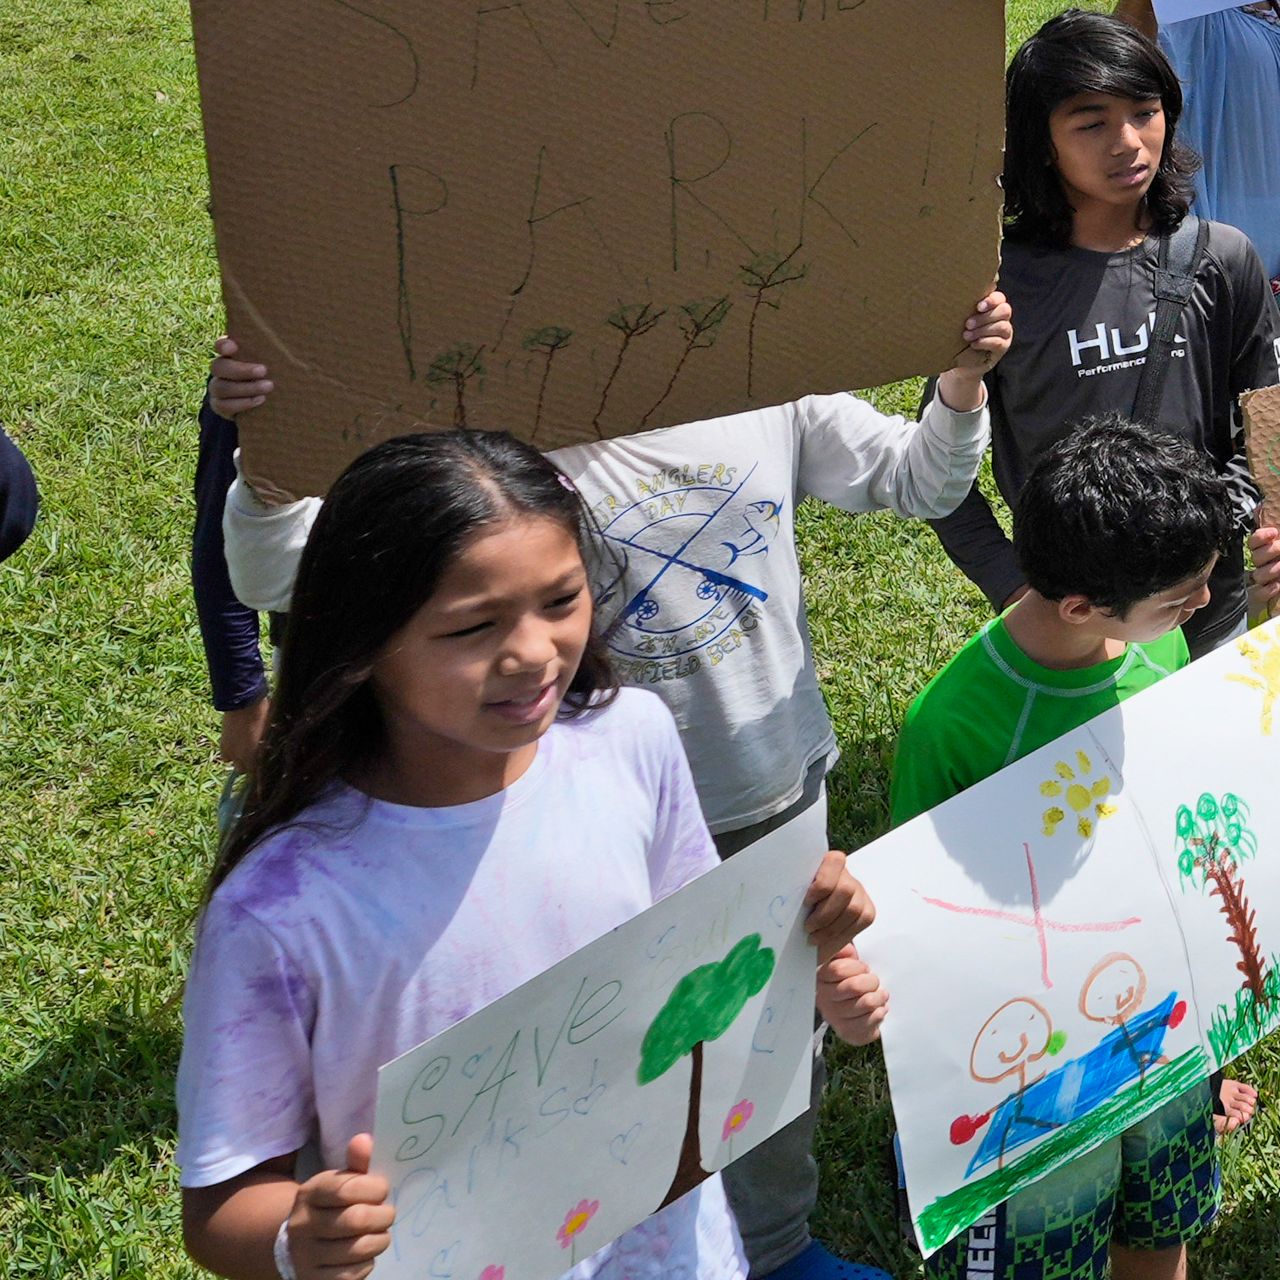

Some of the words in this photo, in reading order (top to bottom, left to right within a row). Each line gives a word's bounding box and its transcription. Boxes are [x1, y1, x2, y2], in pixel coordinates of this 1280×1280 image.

[1077, 356, 1148, 378] Performanc
[635, 462, 738, 500] ANGLERS
[643, 489, 692, 520] DAY
[705, 602, 764, 667] BEACH
